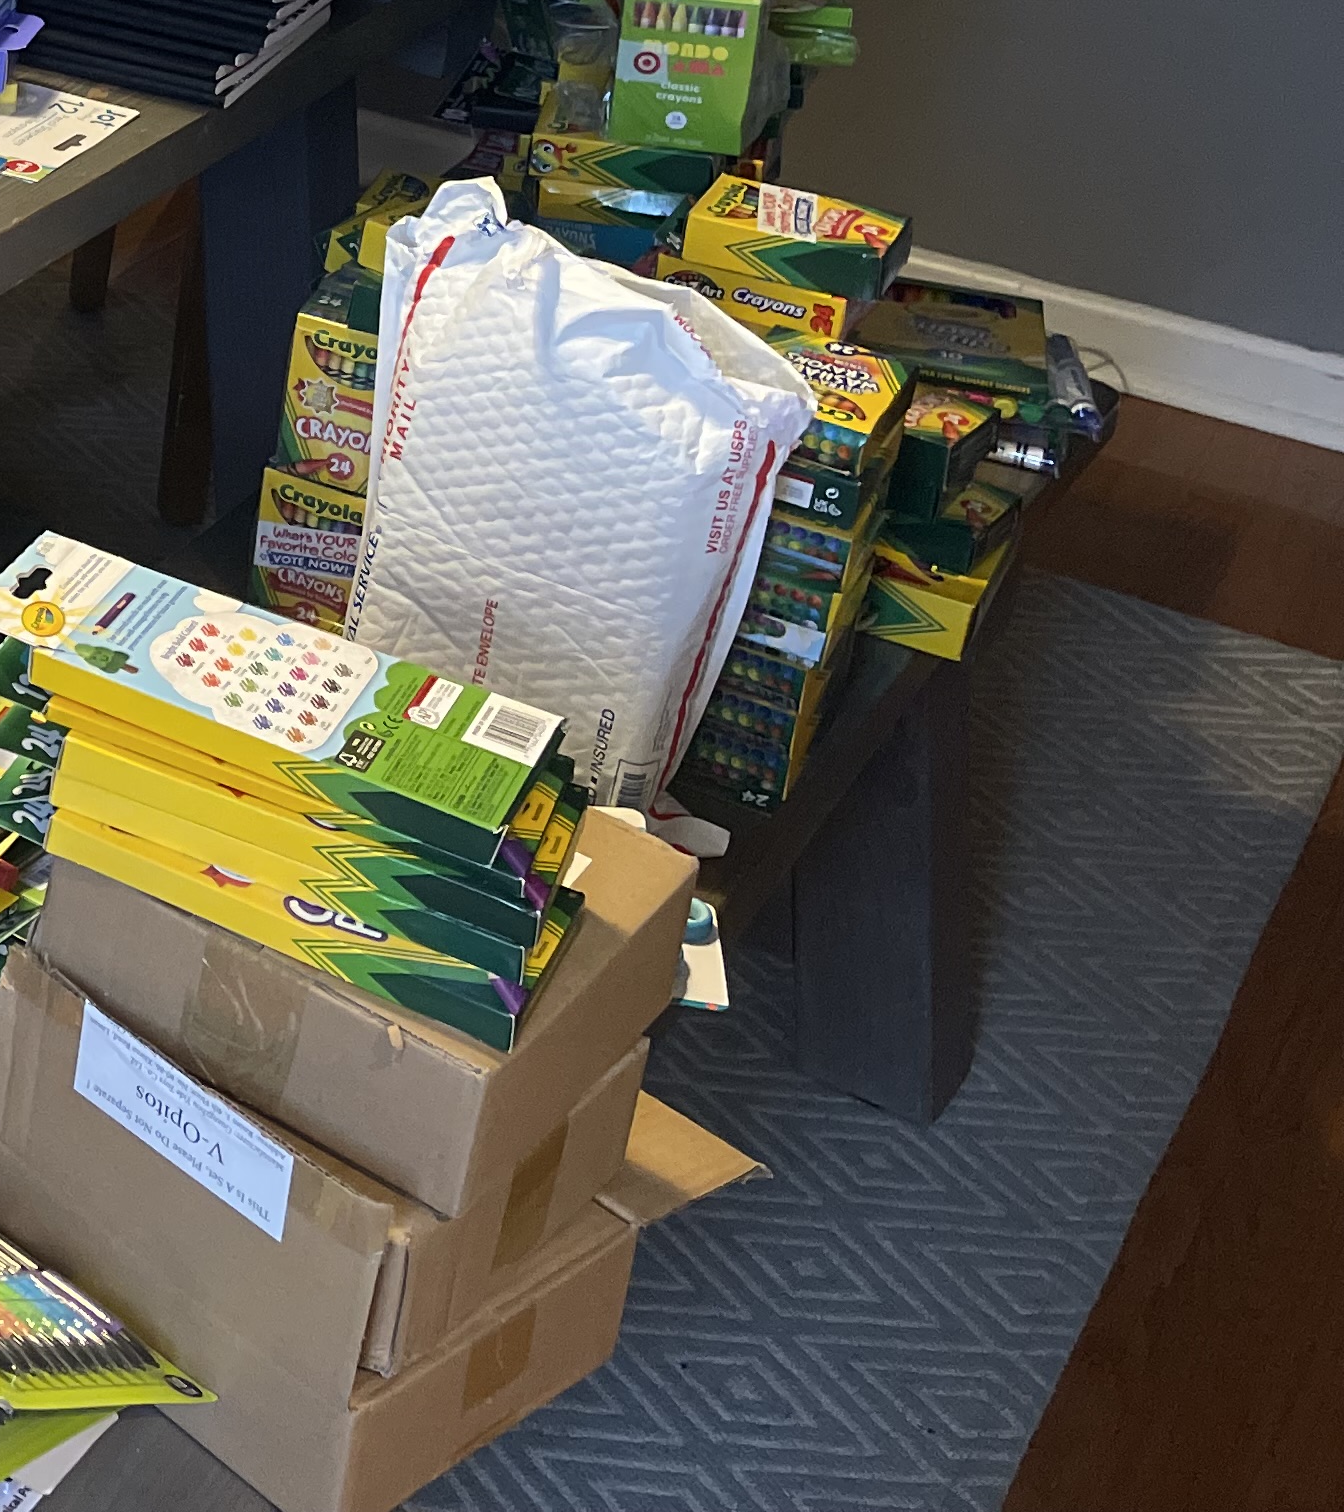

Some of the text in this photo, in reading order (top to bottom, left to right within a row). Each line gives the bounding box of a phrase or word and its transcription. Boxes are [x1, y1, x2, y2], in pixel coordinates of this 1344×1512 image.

[655, 92, 703, 104] crayons
[660, 82, 701, 94] classic
[47, 99, 85, 115] 12
[90, 109, 128, 130] jot
[732, 287, 808, 319] Crayons
[809, 302, 836, 336] 24
[313, 329, 377, 361] Crayo
[389, 399, 417, 462] MAIL
[328, 457, 352, 474] 24
[704, 419, 748, 555] VISIT US AT USPS
[729, 480, 743, 514] FREE
[279, 483, 363, 528] Crayola
[313, 531, 358, 550] YOUR
[272, 553, 352, 575] VOTE NOW!
[352, 531, 380, 612] SERVICE
[276, 568, 345, 605] CRAYONS
[477, 597, 500, 667] ENVELOPE
[21, 724, 66, 759] 24
[592, 707, 616, 772] INSURED
[12, 801, 56, 834] 24
[90, 1082, 135, 1119] Separate
[131, 1113, 154, 1133] Not
[136, 1084, 225, 1166] V-Opitos
[150, 1128, 171, 1147] Do
[169, 1141, 205, 1171] Please
[222, 1180, 236, 1193] A
[233, 1188, 247, 1202] Is
[243, 1196, 274, 1222] This
